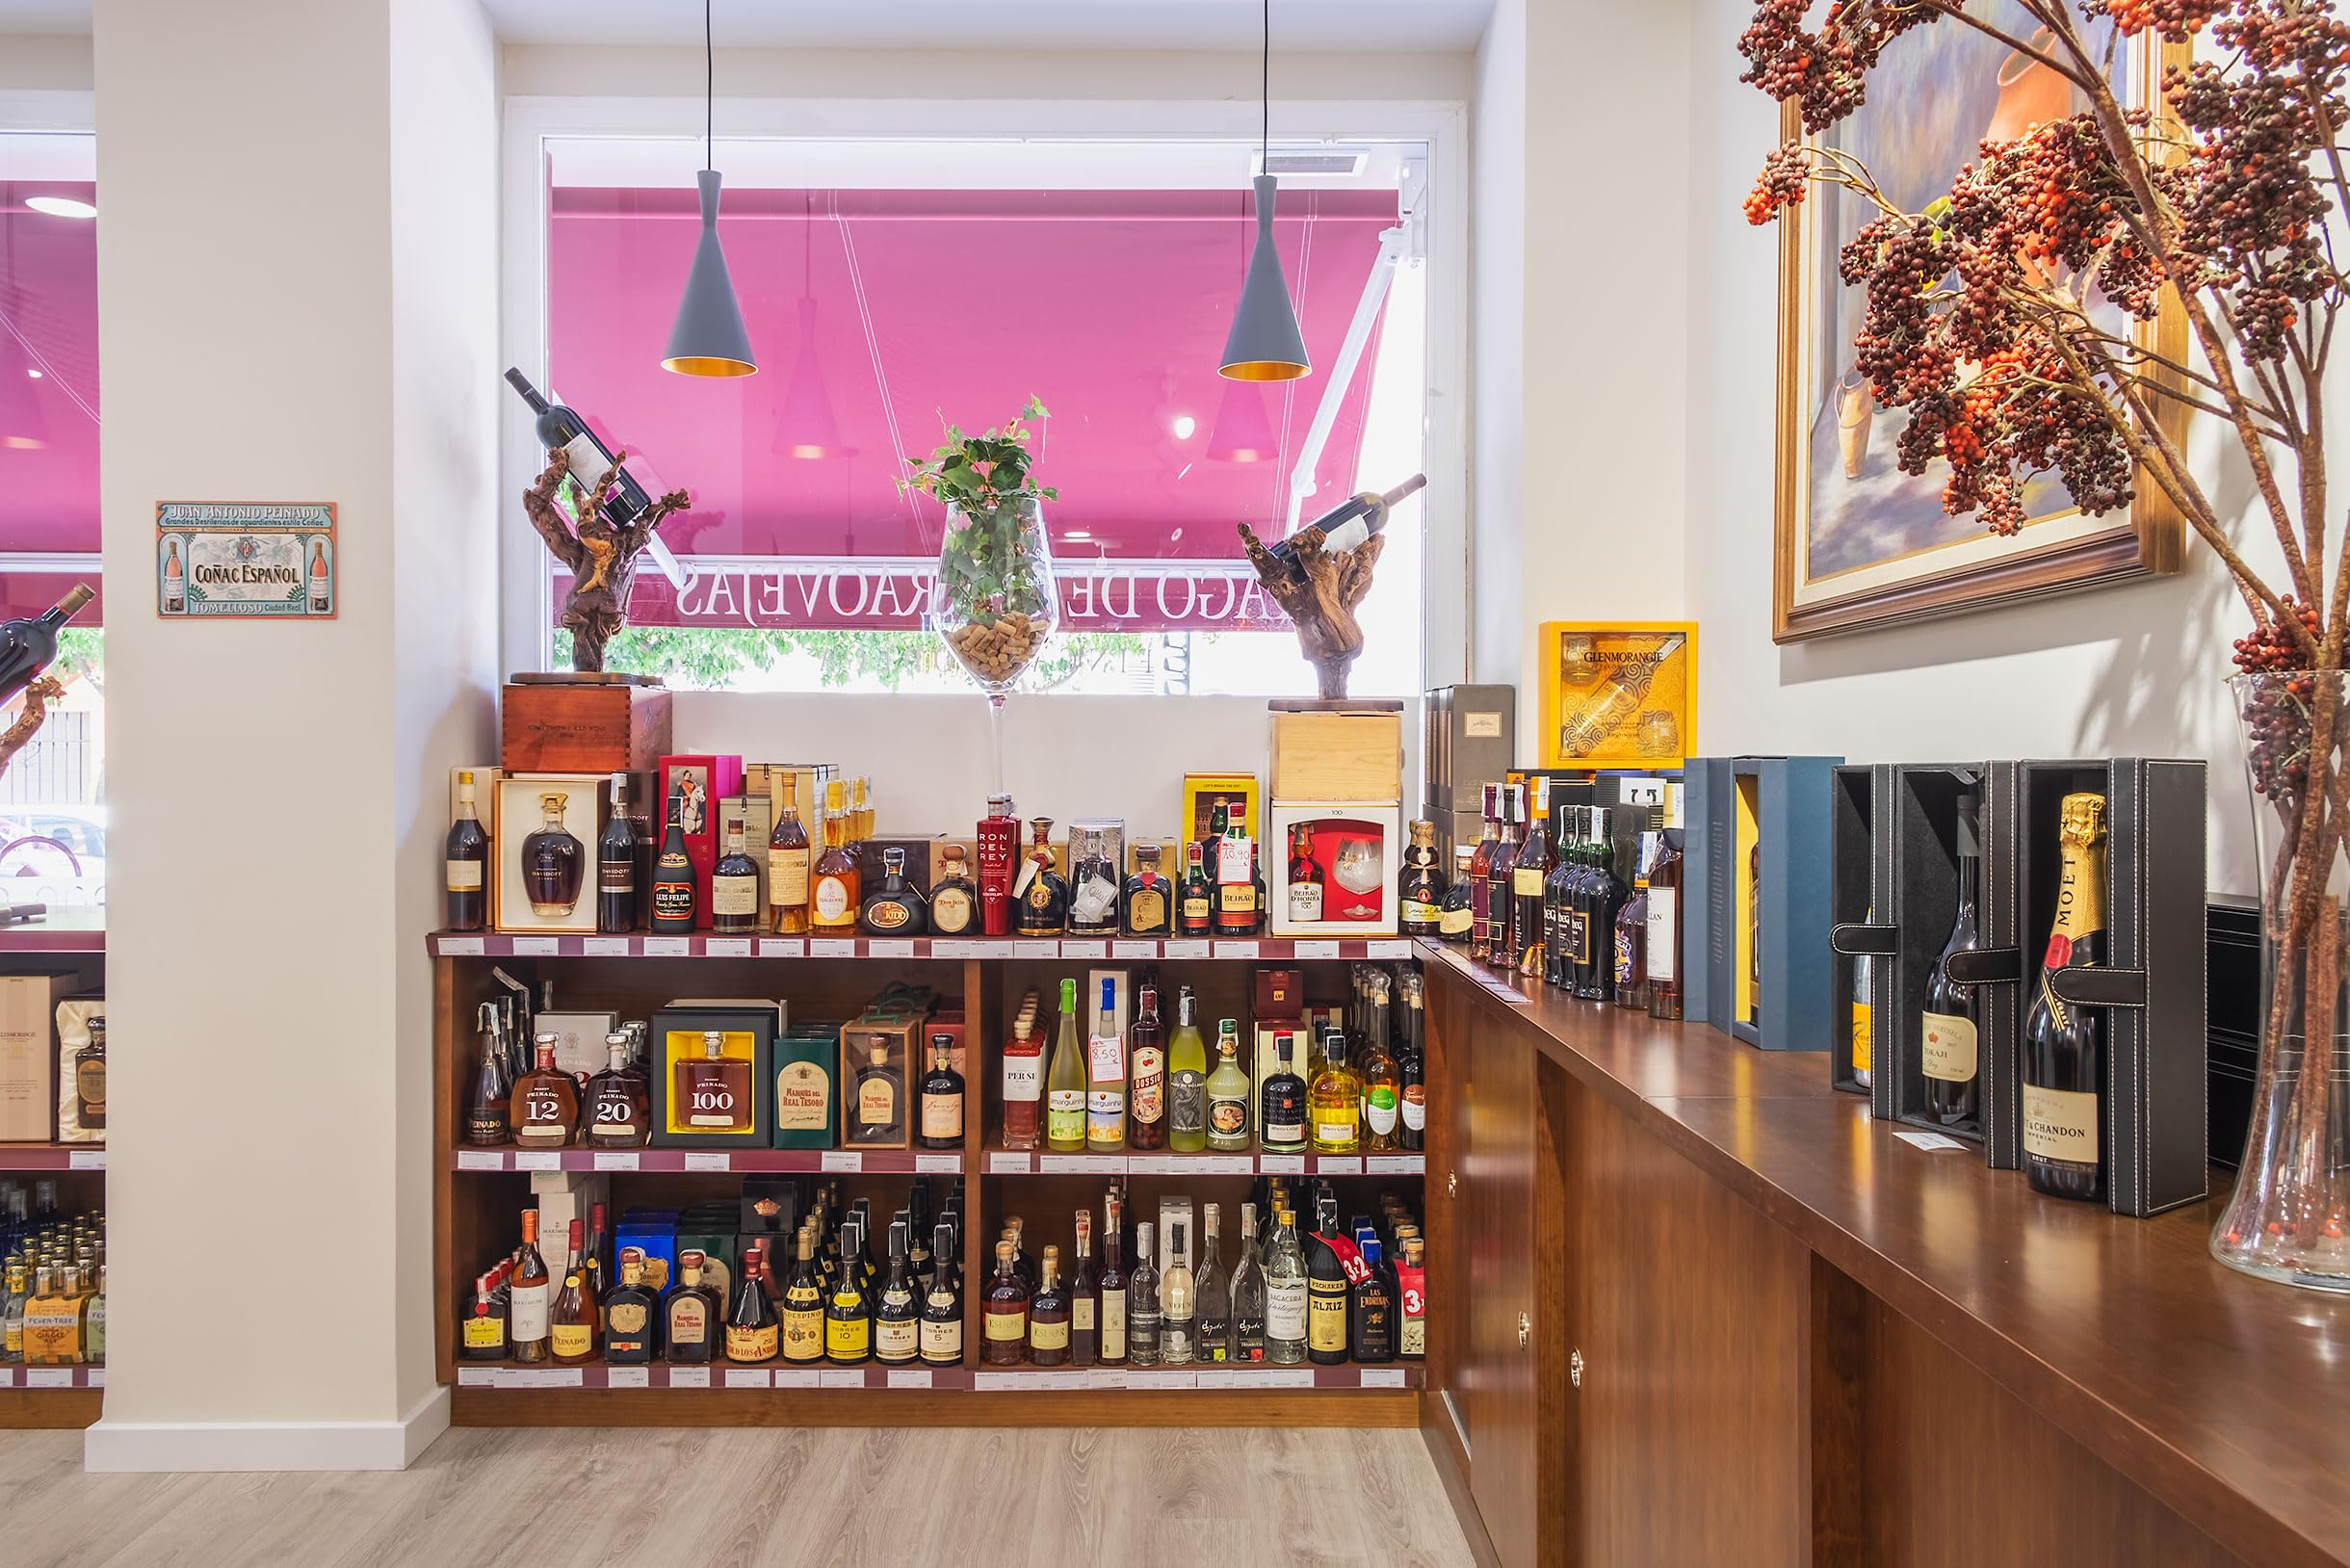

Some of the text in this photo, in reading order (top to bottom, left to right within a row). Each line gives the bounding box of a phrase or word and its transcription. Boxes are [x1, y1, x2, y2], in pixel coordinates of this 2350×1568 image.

[170, 505, 321, 520] JUAN ANTONIO PEINADO
[195, 602, 264, 614] TOMELLOSO
[1584, 651, 1664, 663] GLENMORANGIE
[668, 893, 690, 902] FELIPE
[691, 1092, 734, 1111] 100
[783, 1097, 824, 1107] REAL TESORO
[526, 1101, 560, 1120] 12
[596, 1103, 632, 1122] 20
[2034, 1122, 2085, 1137] CHANDON
[2031, 1154, 2048, 1163] BRUT
[1312, 1300, 1344, 1311] ALAIZ
